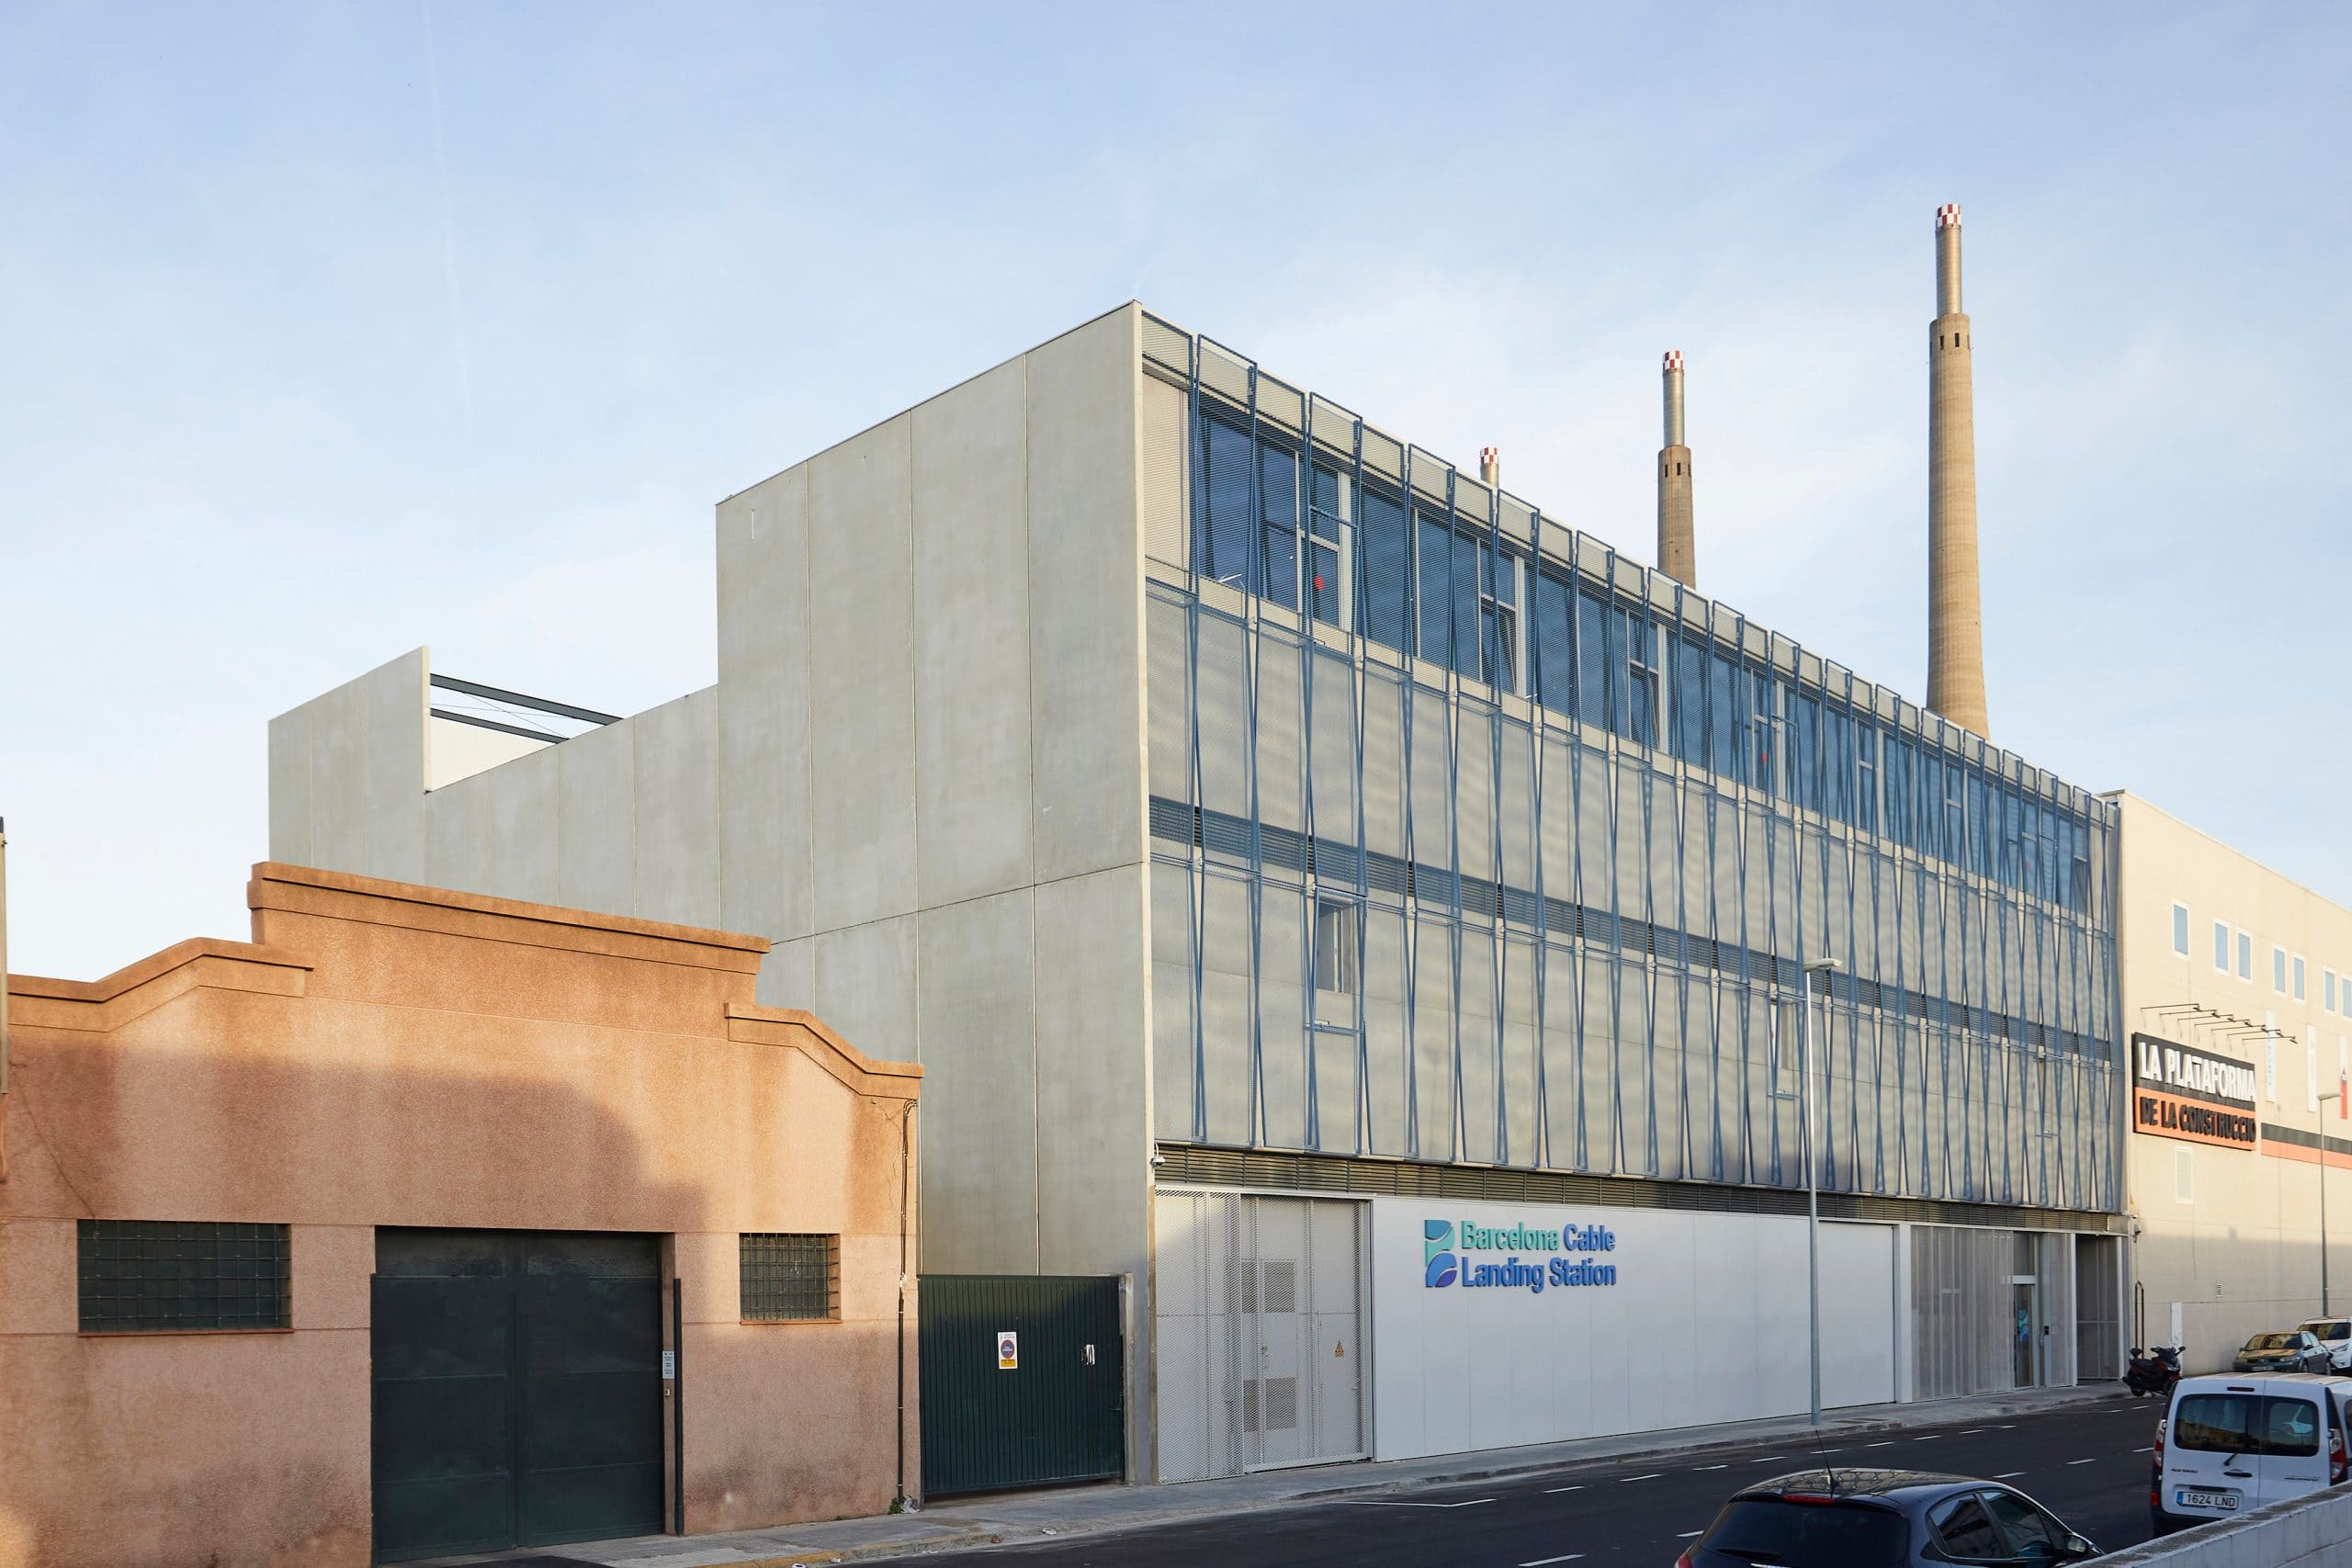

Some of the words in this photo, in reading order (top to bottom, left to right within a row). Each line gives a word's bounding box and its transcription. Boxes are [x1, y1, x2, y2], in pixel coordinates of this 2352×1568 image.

[2139, 1042, 2162, 1082] LA
[2165, 1048, 2256, 1102] PLATAFORMA
[2140, 1096, 2158, 1125] DE
[2161, 1100, 2177, 1130] LA
[1461, 1220, 1558, 1250] Barcelona
[1563, 1223, 1616, 1251] Cable
[1462, 1256, 1545, 1293] Landing
[1549, 1257, 1617, 1287] Station
[2188, 1494, 2211, 1505] 1624
[2214, 1496, 2235, 1507] LND
